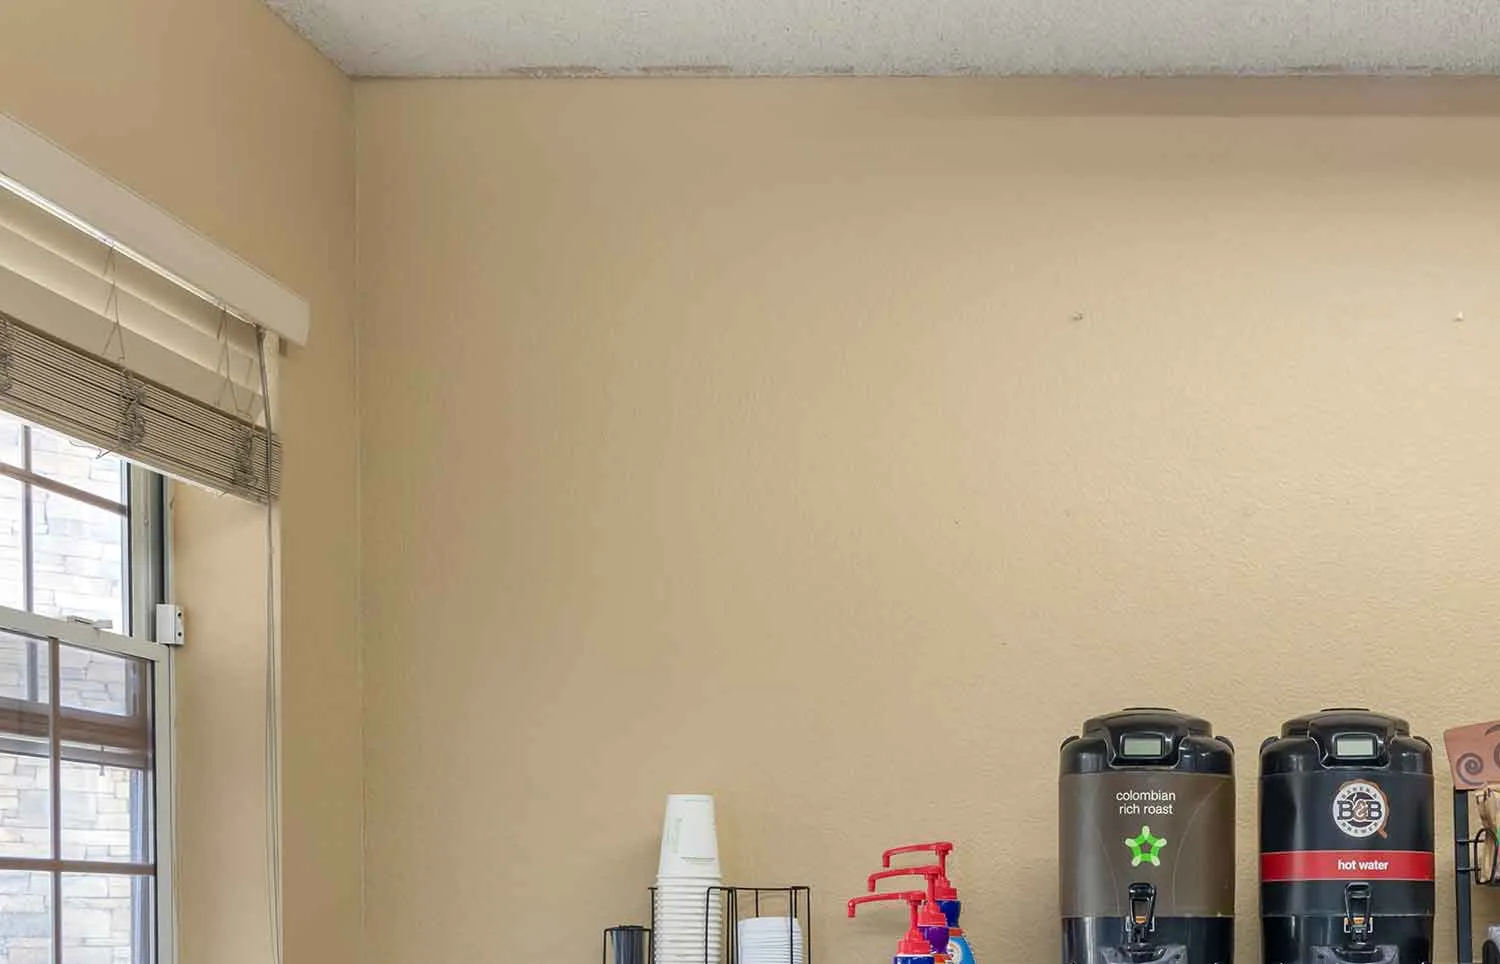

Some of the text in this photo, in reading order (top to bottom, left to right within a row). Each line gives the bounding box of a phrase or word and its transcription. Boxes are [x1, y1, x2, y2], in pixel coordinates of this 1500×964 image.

[1116, 789, 1176, 801] colombian
[1119, 803, 1174, 815] rich roast
[1337, 859, 1389, 870] hot water
